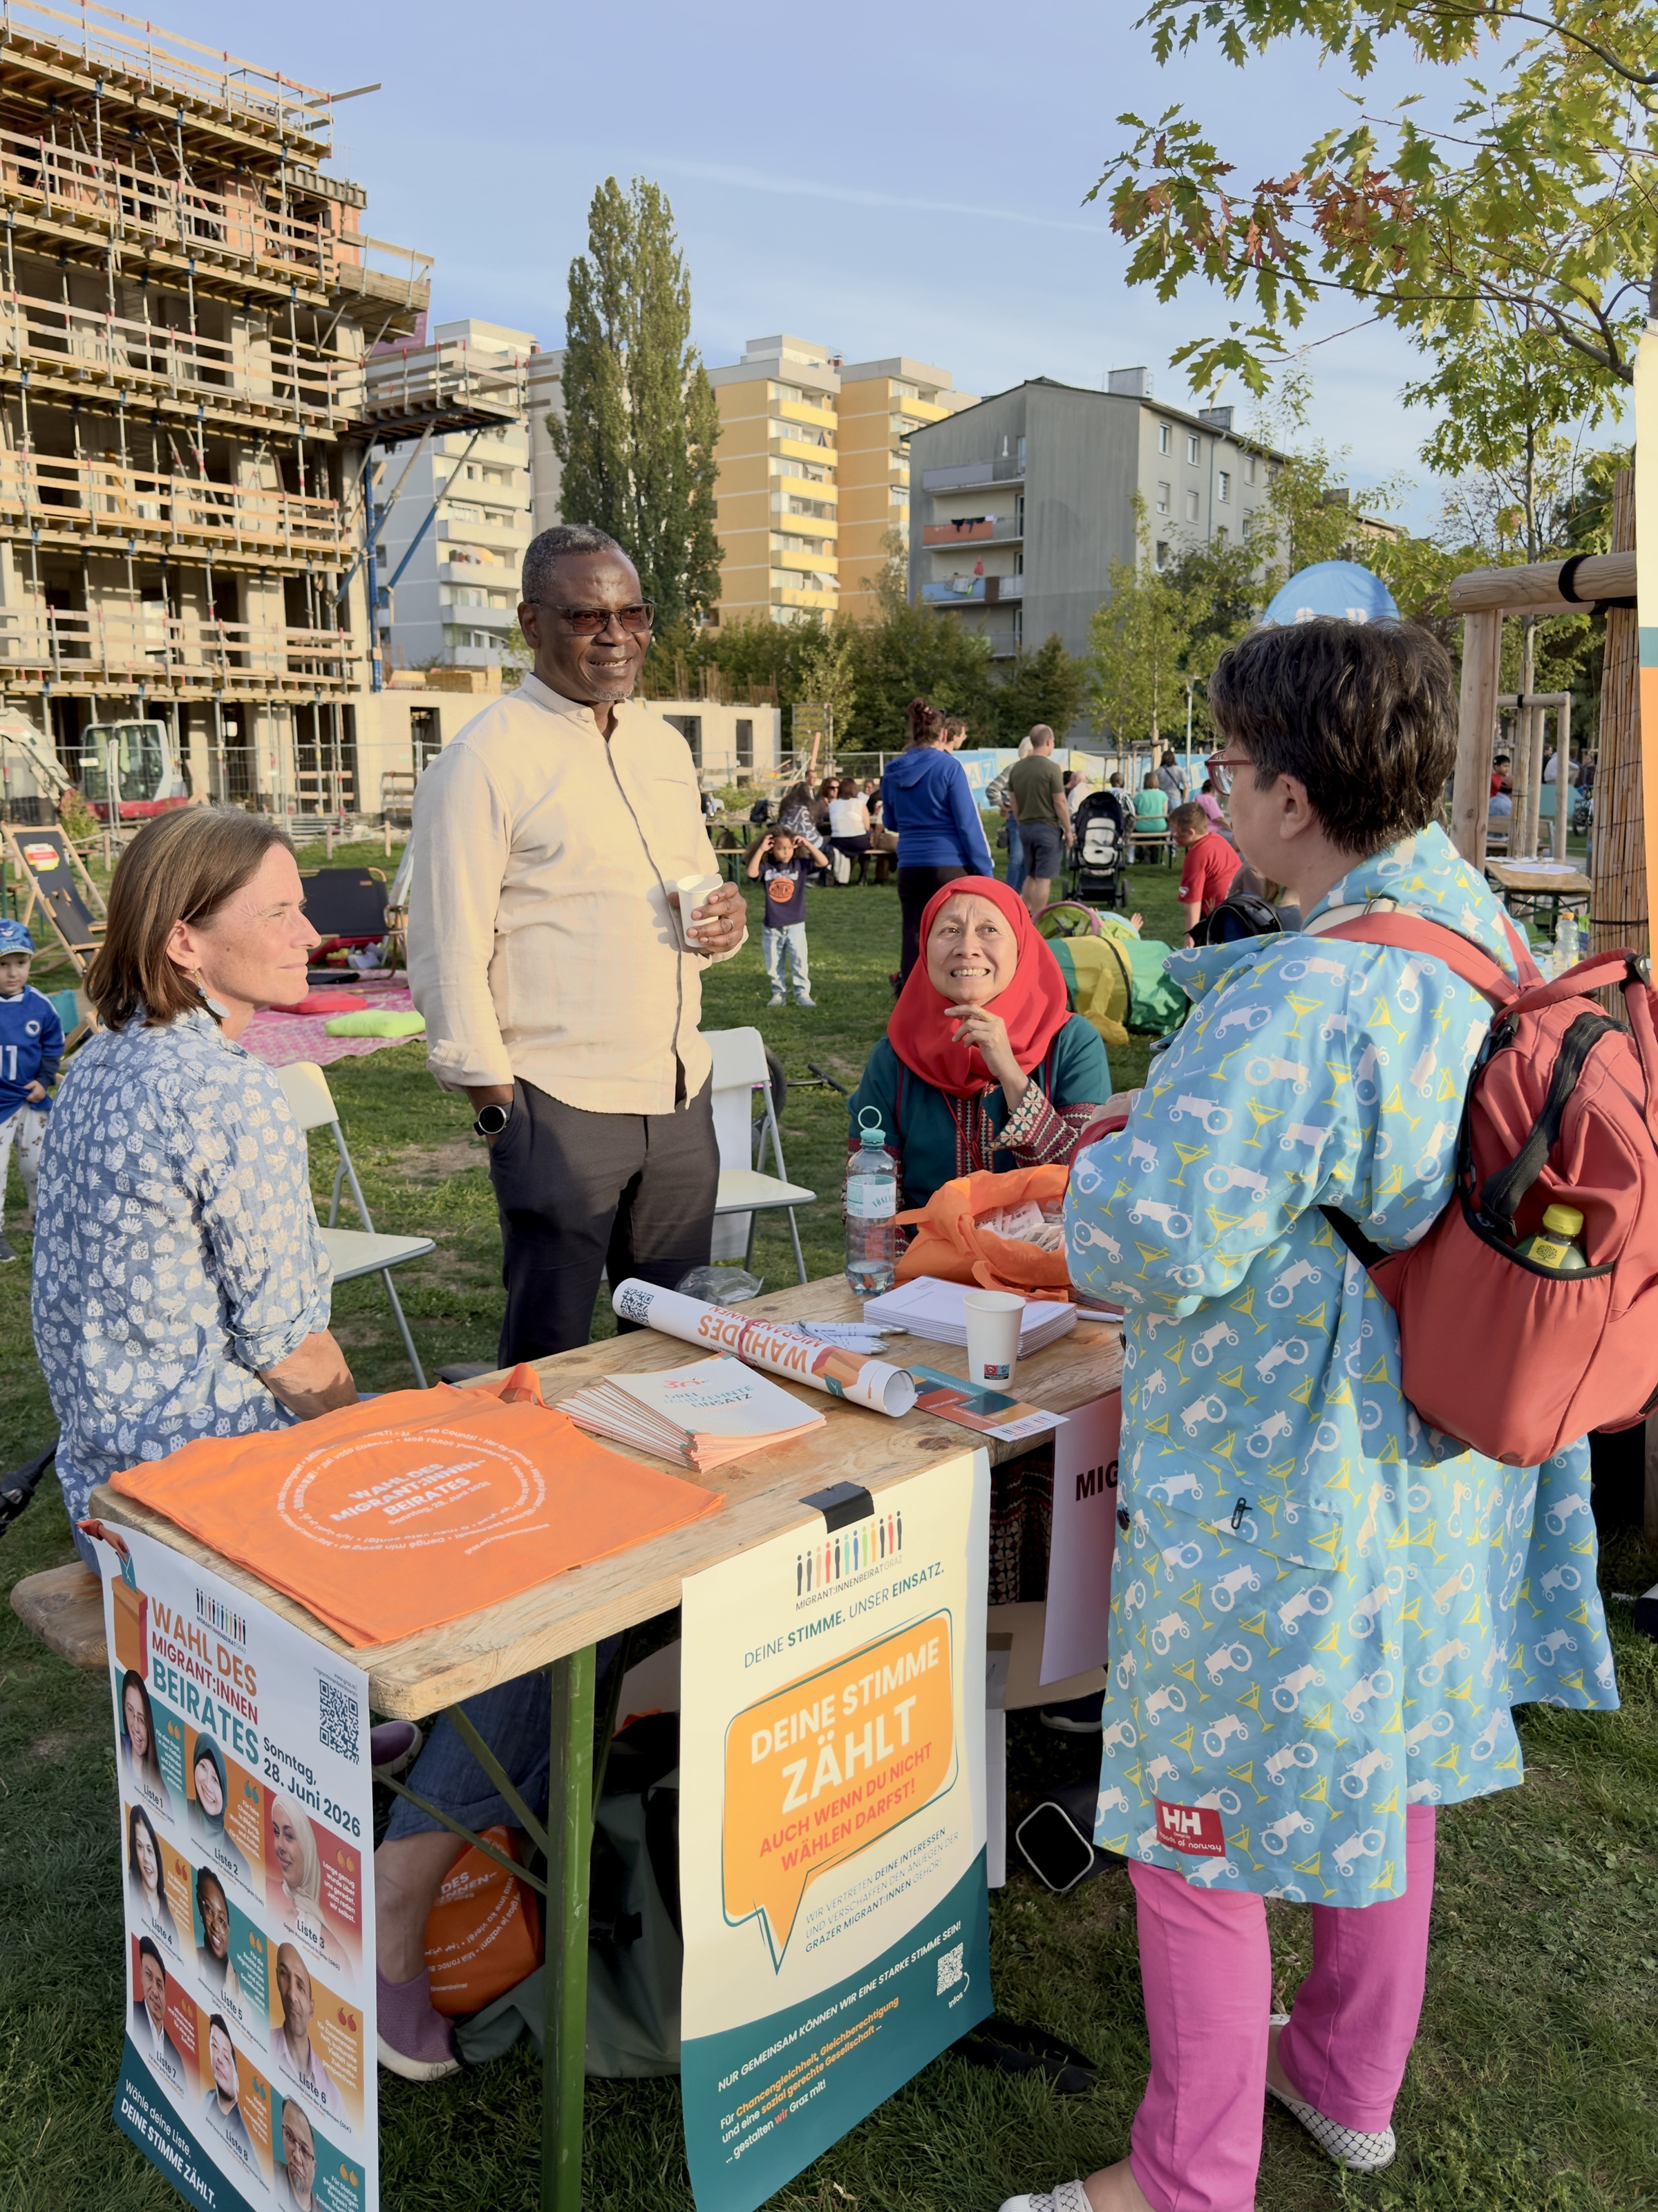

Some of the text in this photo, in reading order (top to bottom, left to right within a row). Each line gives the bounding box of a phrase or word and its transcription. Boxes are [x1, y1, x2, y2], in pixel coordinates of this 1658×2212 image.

[697, 1315, 740, 1347] DES
[662, 1385, 754, 1404] JAHRZEHNTE
[690, 1393, 753, 1408] EINSATZ
[348, 1463, 444, 1499] WAHL DES
[383, 1477, 471, 1517] BEIRATES
[449, 1490, 469, 1503] Juni
[795, 1555, 902, 1611] MIGRANT:INNENBEIRAT GRAZ
[744, 1559, 944, 1668] DEINE STIMME. UNSER EINSATZ.
[151, 1595, 257, 1700] WAHL DES
[151, 1629, 258, 1726] MIGRANT:INNEN
[152, 1656, 258, 1768] BEIRATES
[751, 1635, 939, 1765] DEINE STIMME
[263, 1735, 316, 1790] Sonntag,
[781, 1687, 916, 1815] ZÄHLT
[143, 1783, 159, 1806] Liste
[160, 1797, 162, 1809] 1
[264, 1755, 360, 1841] 28. Juni 2026
[759, 1741, 932, 1858] AUCH WENN DU NICHT
[781, 1777, 915, 1873] WÄHLEN DARFST!
[1162, 1806, 1202, 1835] HH
[214, 1846, 230, 1870] Liste
[231, 1861, 238, 1876] 2
[1178, 1839, 1185, 1847] of
[1188, 1843, 1222, 1853] norway
[323, 1860, 355, 1891] Lange genug
[326, 1871, 355, 1897] wurde über
[441, 1871, 470, 1895] DES
[806, 1830, 958, 1939] UND VERSCHAFFEN DEN ANLIEGEN DER
[807, 1826, 945, 1924] WIR VERTRETEN DEINE INTERESSEN
[324, 1878, 355, 1909] uns geredet.
[327, 1889, 355, 1915] Jetzt reden
[151, 1915, 167, 1940] Liste
[167, 1932, 172, 1945] 4
[339, 1906, 355, 1924] selbst.
[806, 1923, 841, 1953] GRAZER
[844, 1878, 910, 1929] MIGRANT:INNEN
[296, 1918, 324, 1949] Liste 3
[220, 1988, 242, 2022] Liste 5
[718, 1920, 961, 2092] NUR GEMEINSAM KÖNNEN WIR EINE STARKE STIMME SEIN!
[948, 1991, 963, 2009] Infos
[326, 2018, 356, 2048] Gemeinsam
[156, 2047, 176, 2081] Liste 7
[328, 2045, 357, 2073] Vielfalt und
[332, 2041, 357, 2065] kulturelle
[720, 1995, 898, 2130] Für Chancengleichheit, Gleichberechtigung
[299, 2072, 326, 2104] Liste 6
[722, 2024, 874, 2144] und eine sozial gerechte Gesellschaft
[125, 2079, 149, 2112] Wähle
[149, 2108, 171, 2137] deine
[172, 2126, 191, 2159] Liste.
[733, 2078, 825, 2161] gestalten wir Graz mit!
[120, 2097, 147, 2135] DEINE
[147, 2126, 182, 2175] STIMME
[182, 2166, 216, 2209] ZÄHLT.
[225, 2126, 242, 2156] Liste
[243, 2147, 247, 2162] 8
[340, 2183, 359, 2202] Dialog,
